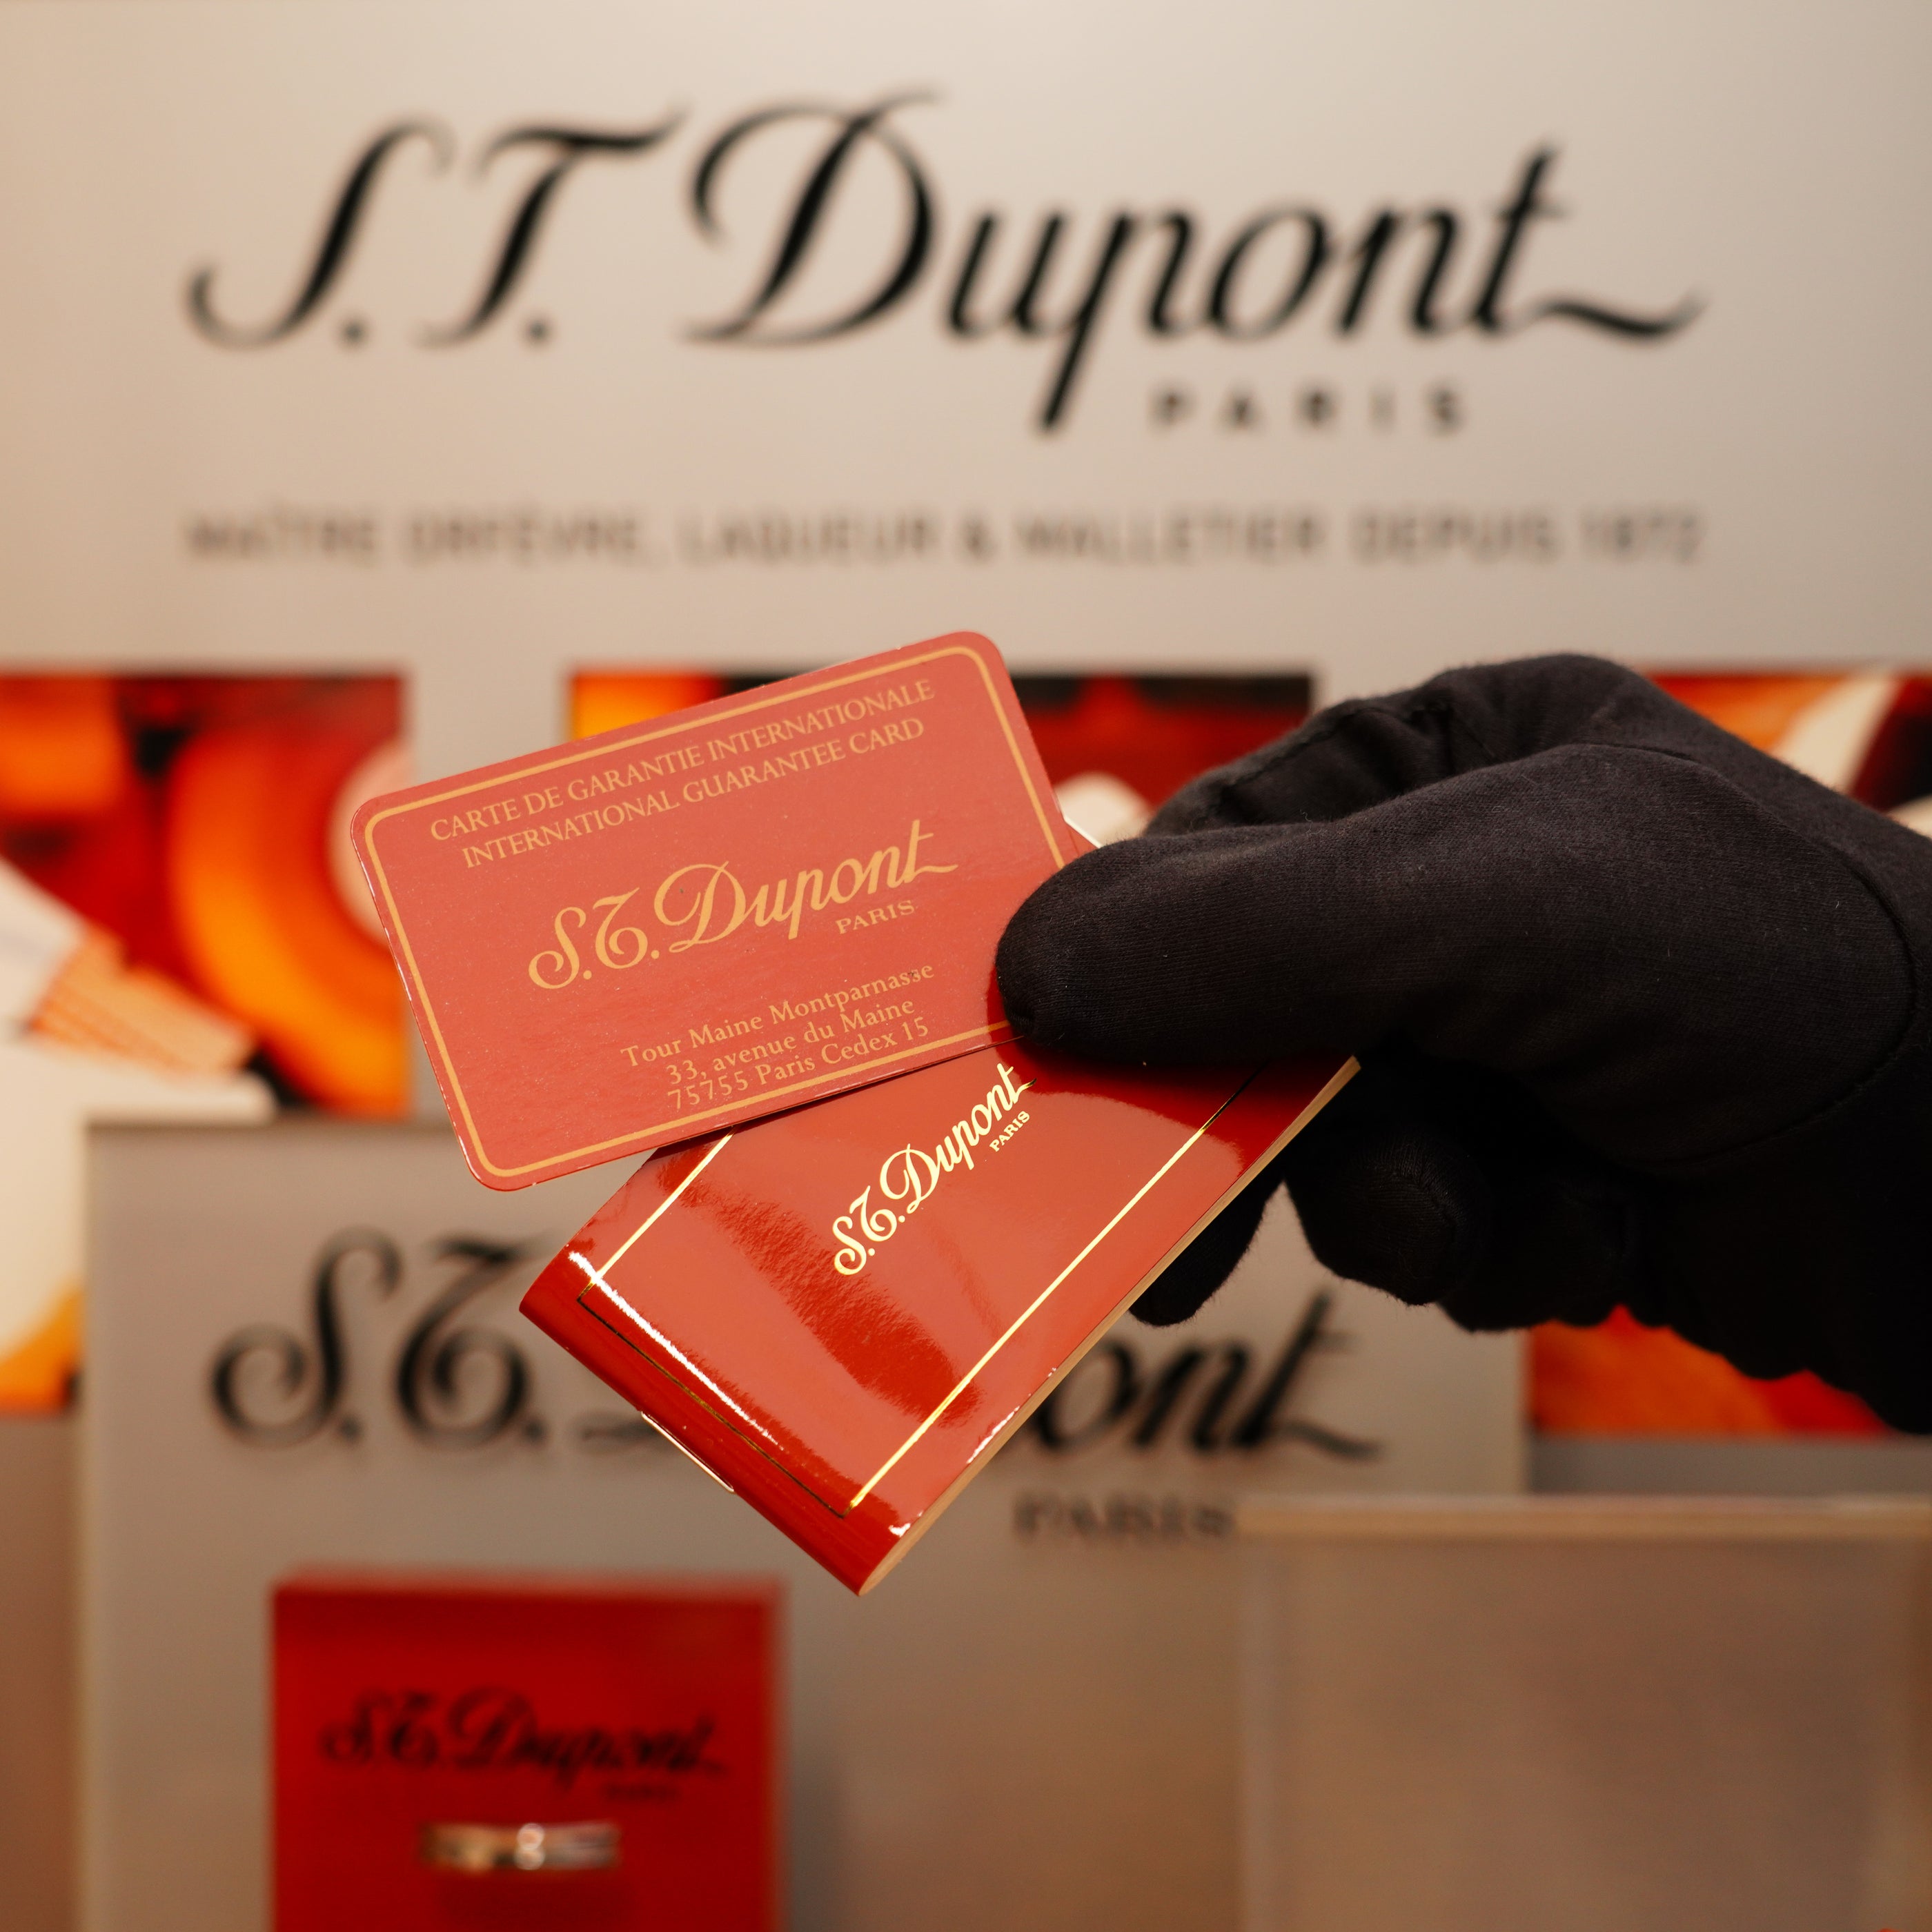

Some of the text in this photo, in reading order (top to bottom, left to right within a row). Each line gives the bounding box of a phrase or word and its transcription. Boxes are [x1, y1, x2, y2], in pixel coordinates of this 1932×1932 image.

[184, 84, 1708, 436] S.T. Dupont
[1150, 383, 1467, 435] PARIS
[431, 679, 935, 840] CARTE DE GARANTIE INTERNATIONALE
[462, 718, 925, 869] INTERNATIONAL GUARANTEE CARD
[836, 900, 915, 934] PARIS
[620, 965, 934, 1067] Tour Maine Montparnasse
[666, 1000, 916, 1085] 33, avenue du Maine
[667, 1016, 929, 1110] 75755 Paris Cedex 15
[989, 1111, 1030, 1152] PARIS
